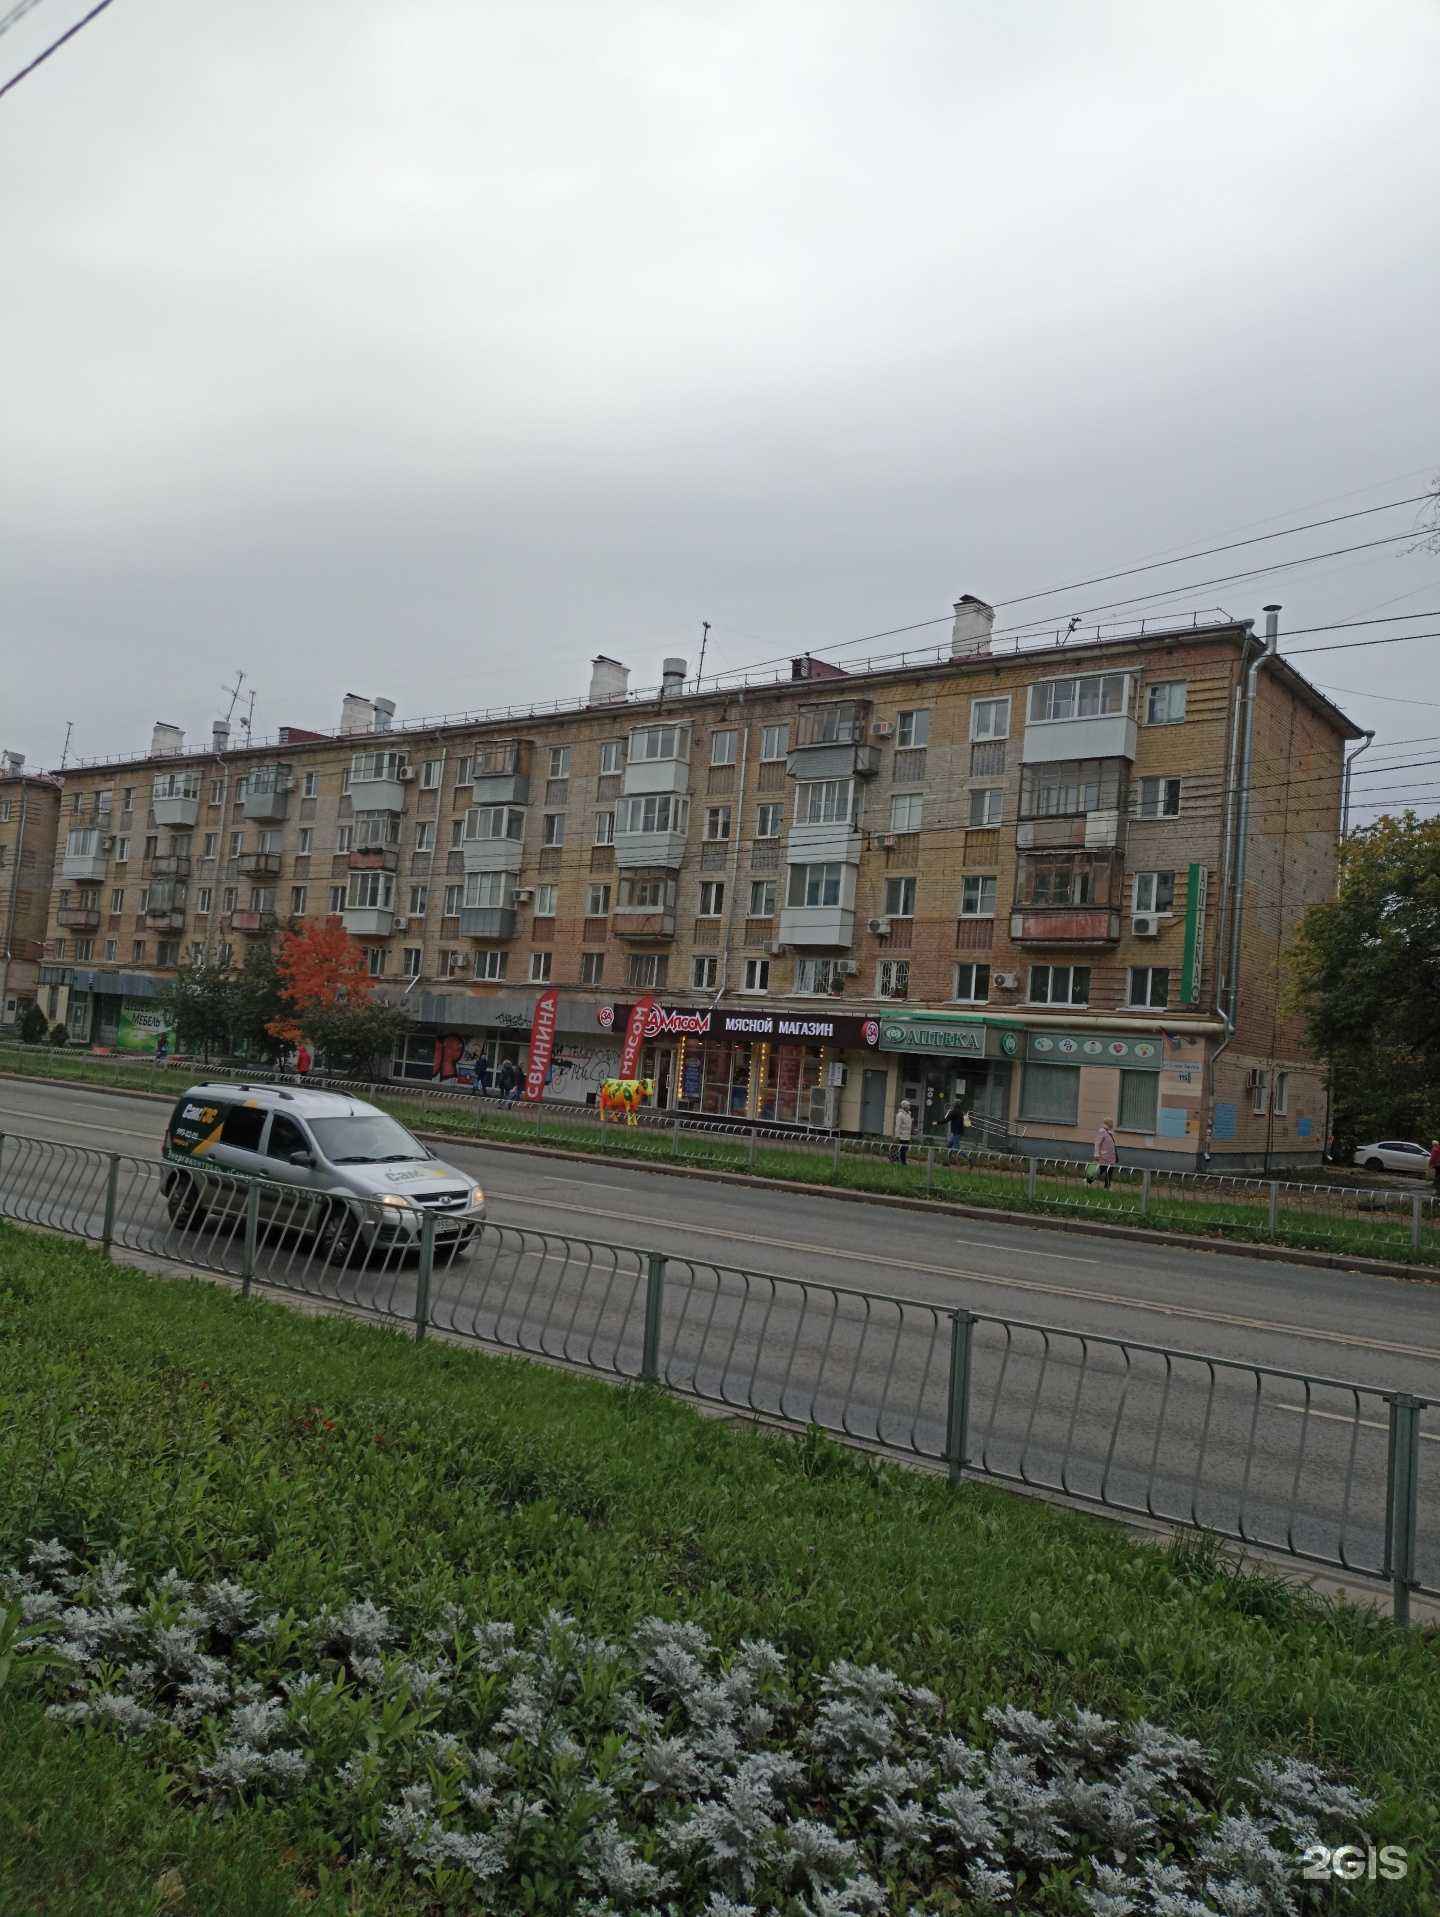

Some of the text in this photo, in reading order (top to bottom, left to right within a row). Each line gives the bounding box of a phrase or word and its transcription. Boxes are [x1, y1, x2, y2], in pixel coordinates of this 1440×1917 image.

[527, 999, 555, 1098] СВИНИНА
[622, 1007, 649, 1075] МЯСОМ
[725, 1017, 773, 1033] МЯСНОЙ
[778, 1021, 833, 1037] МАГАЗИН
[905, 1029, 979, 1049] АПТЕКА
